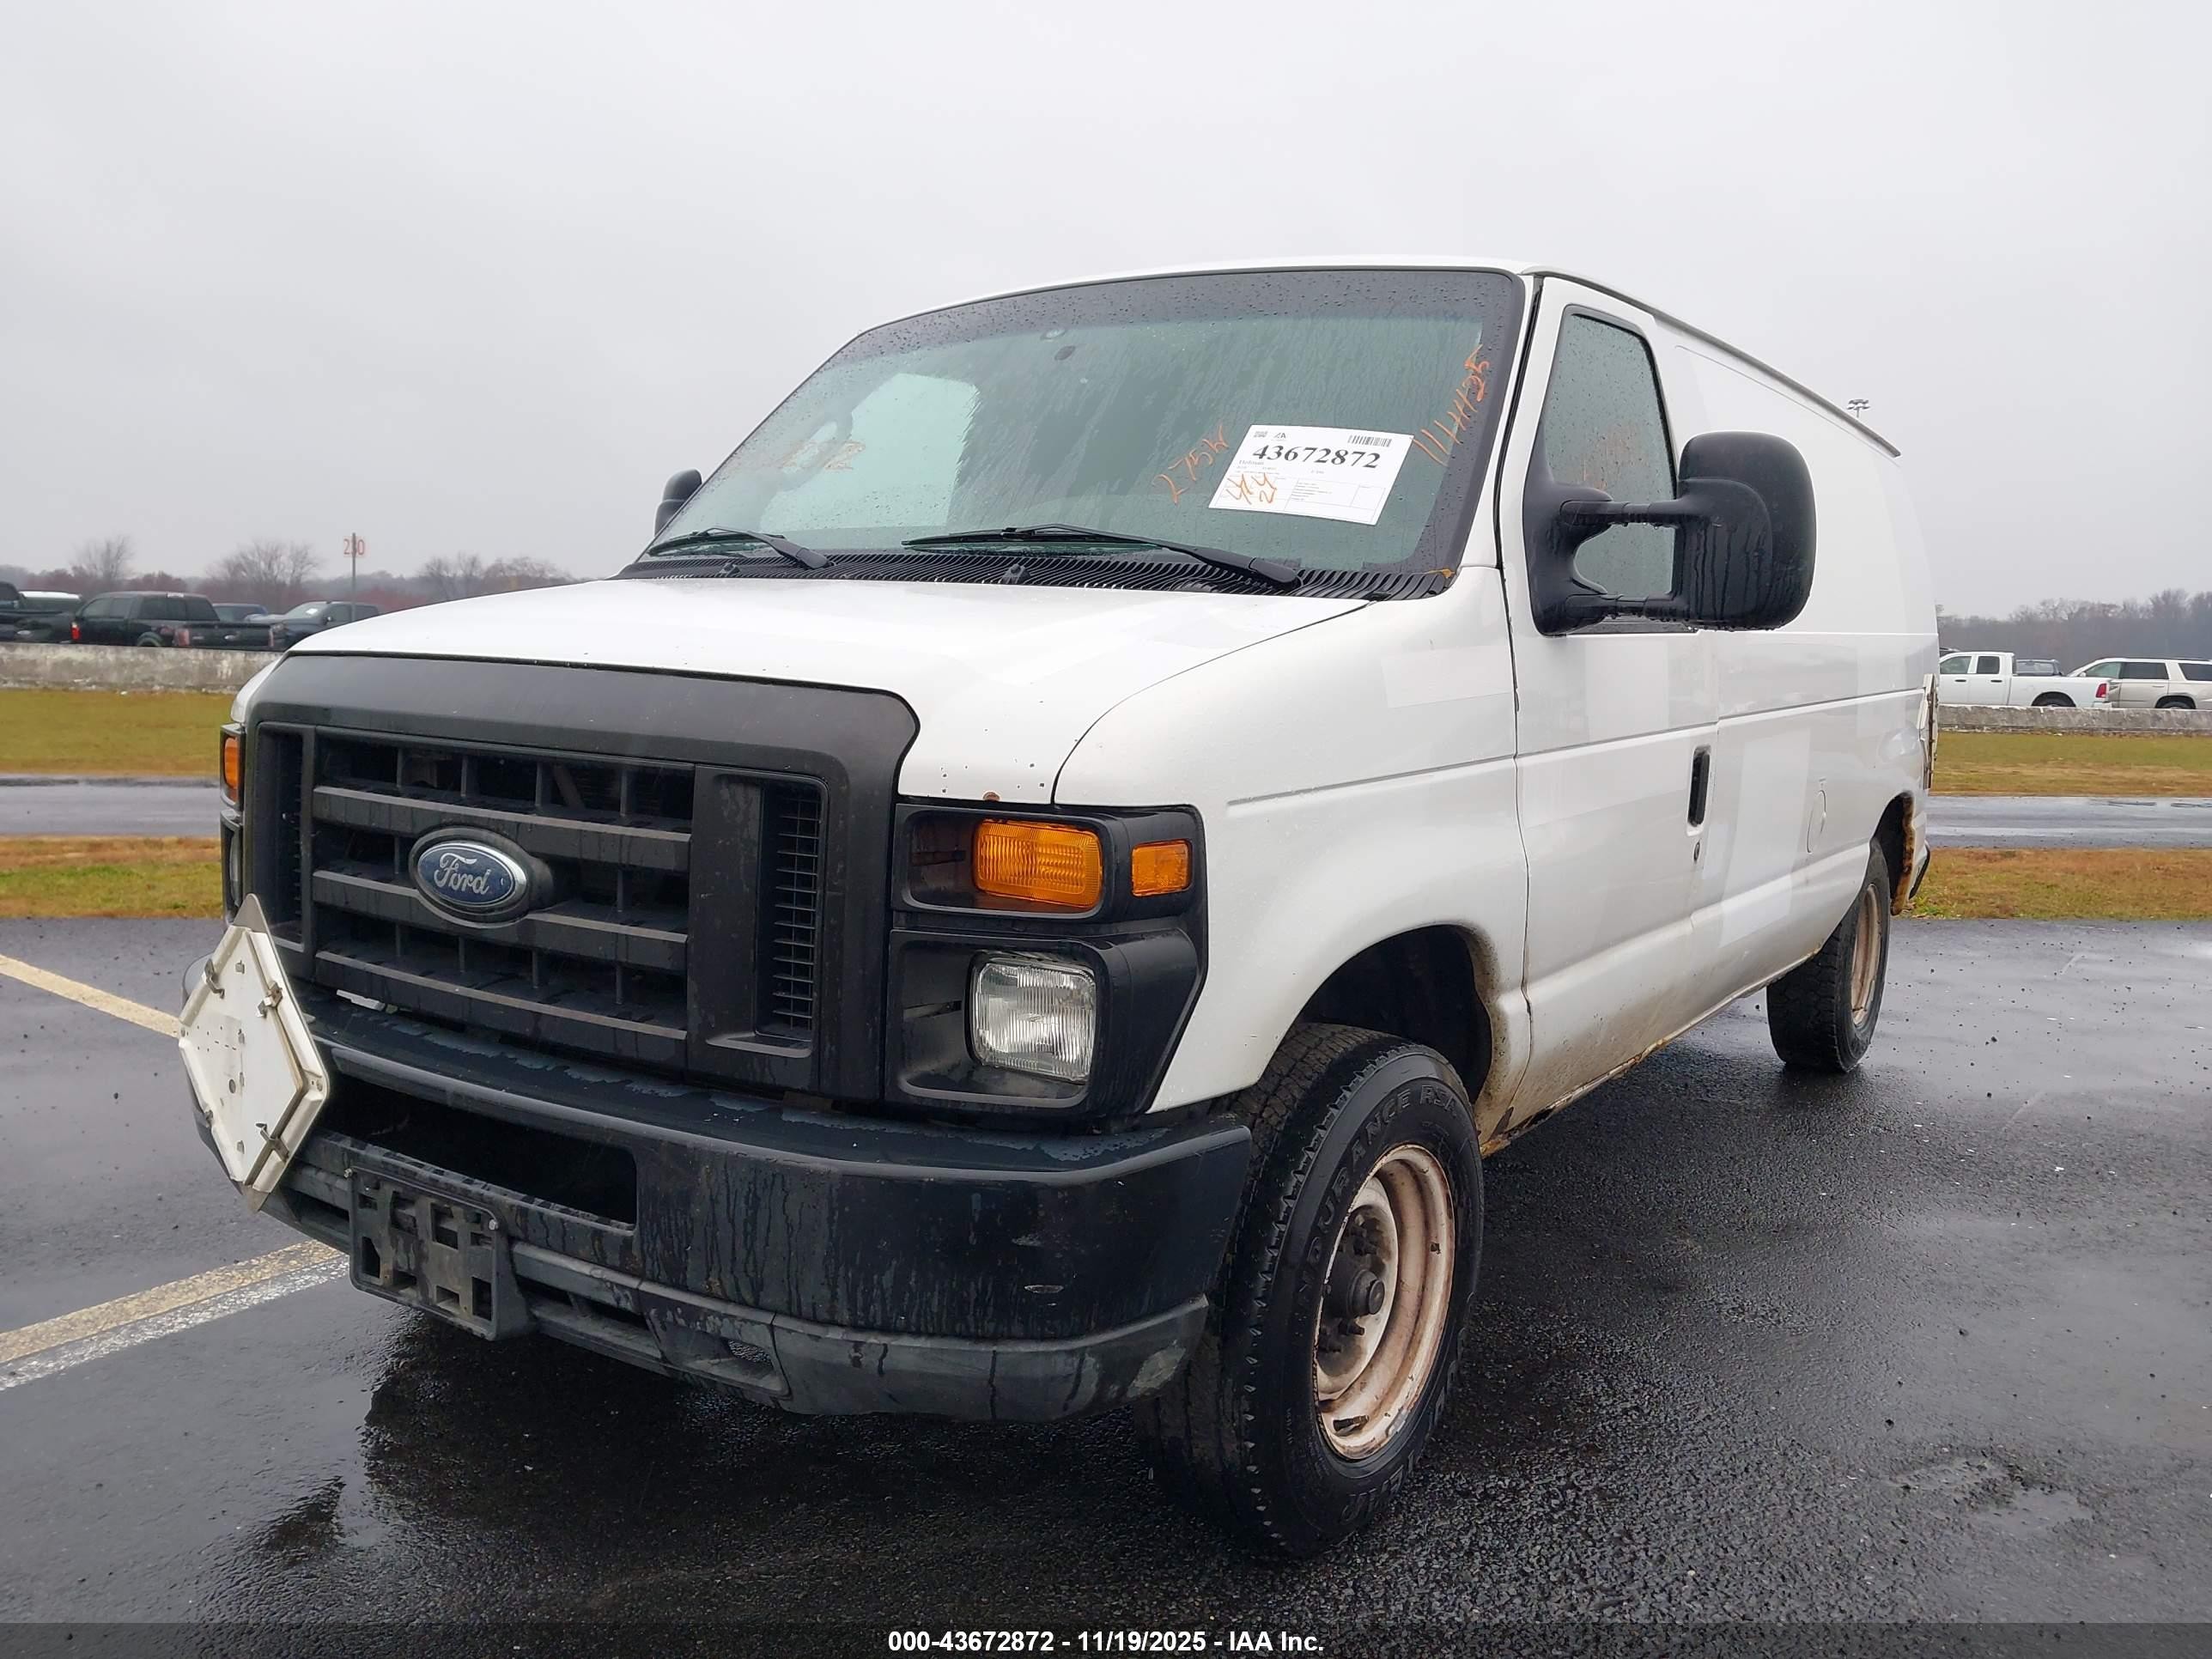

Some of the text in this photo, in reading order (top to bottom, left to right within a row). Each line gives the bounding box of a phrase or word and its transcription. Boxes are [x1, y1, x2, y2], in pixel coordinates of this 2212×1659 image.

[1252, 444, 1381, 469] 43672872
[343, 538, 365, 556] 20
[434, 852, 492, 895] Ford
